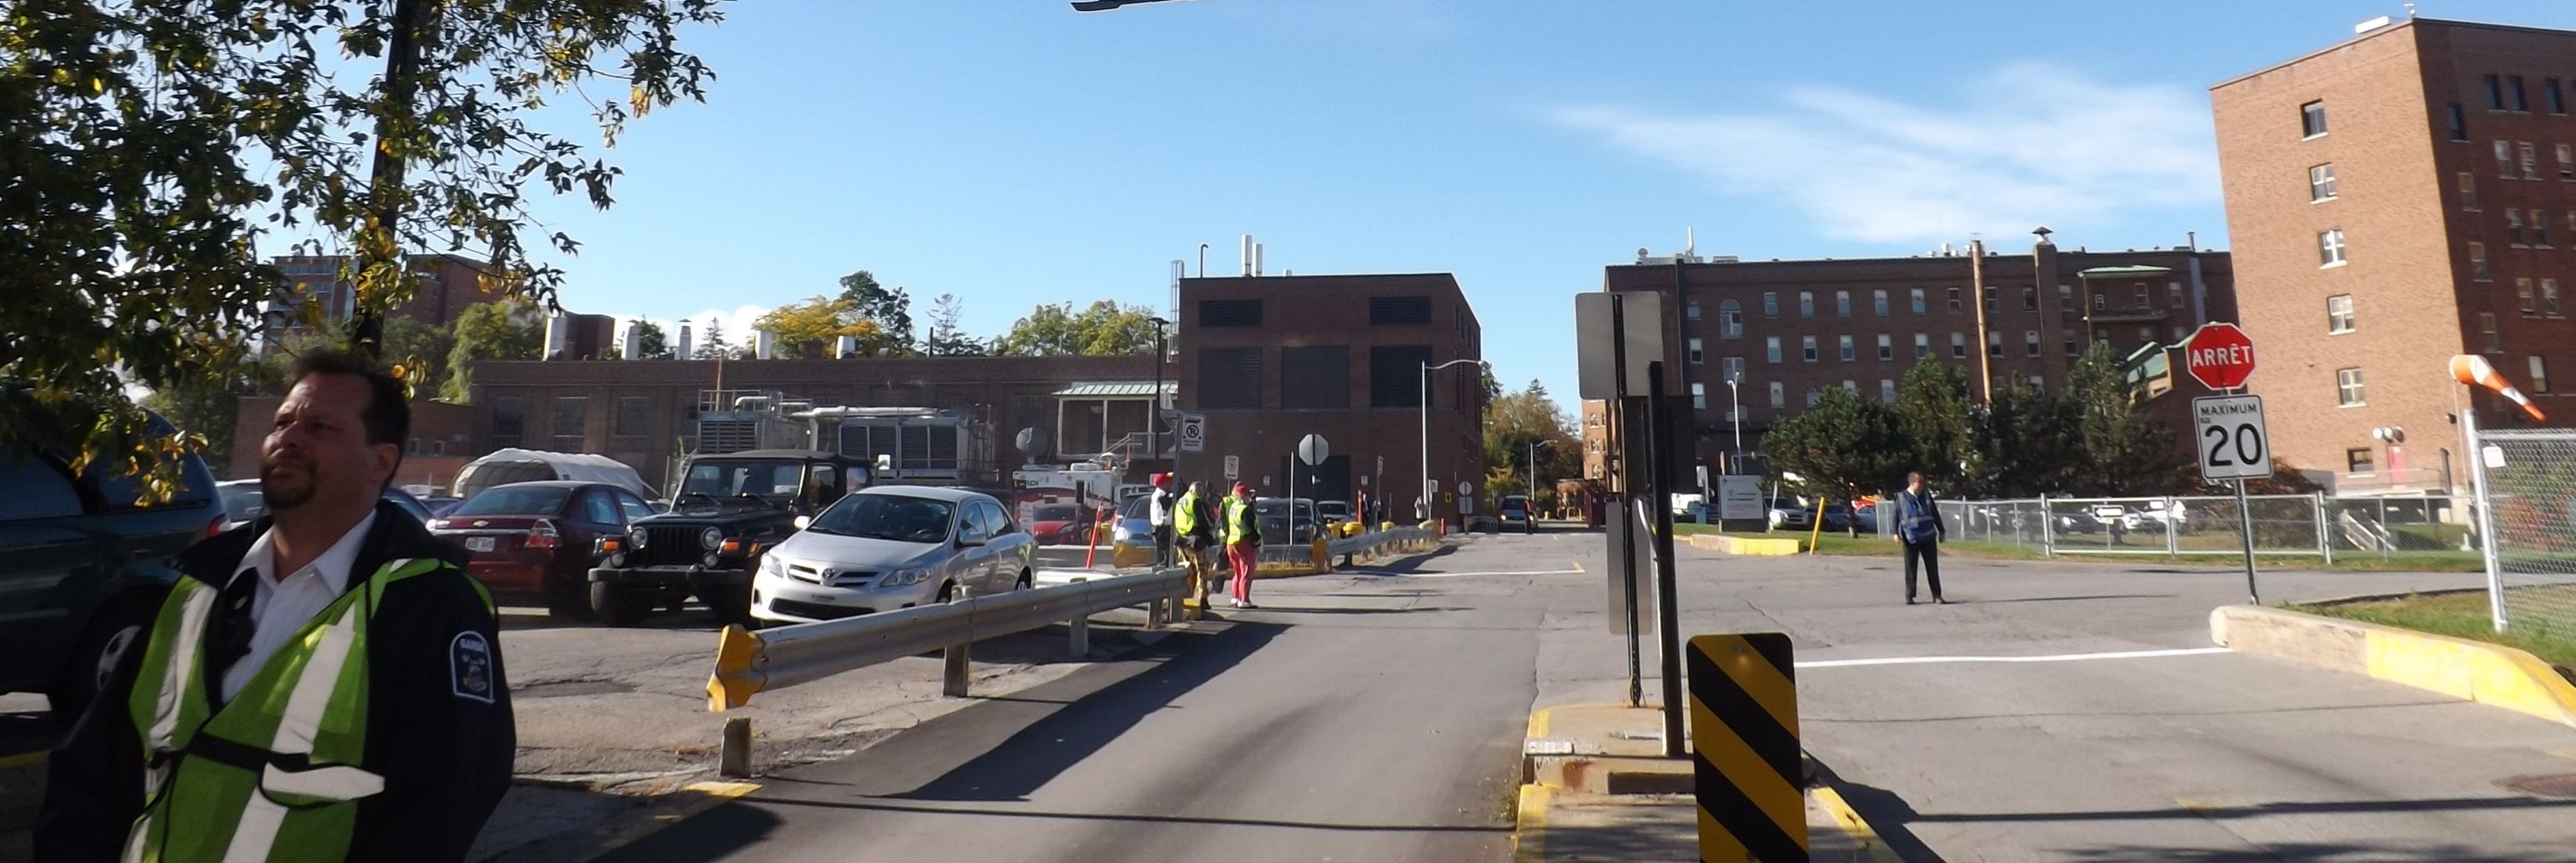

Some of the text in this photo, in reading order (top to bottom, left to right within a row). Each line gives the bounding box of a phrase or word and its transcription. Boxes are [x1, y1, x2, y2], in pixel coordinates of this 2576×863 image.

[2192, 343, 2250, 366] ARRÊT
[2200, 403, 2257, 416] MAXIMUM
[2205, 423, 2261, 467] 20
